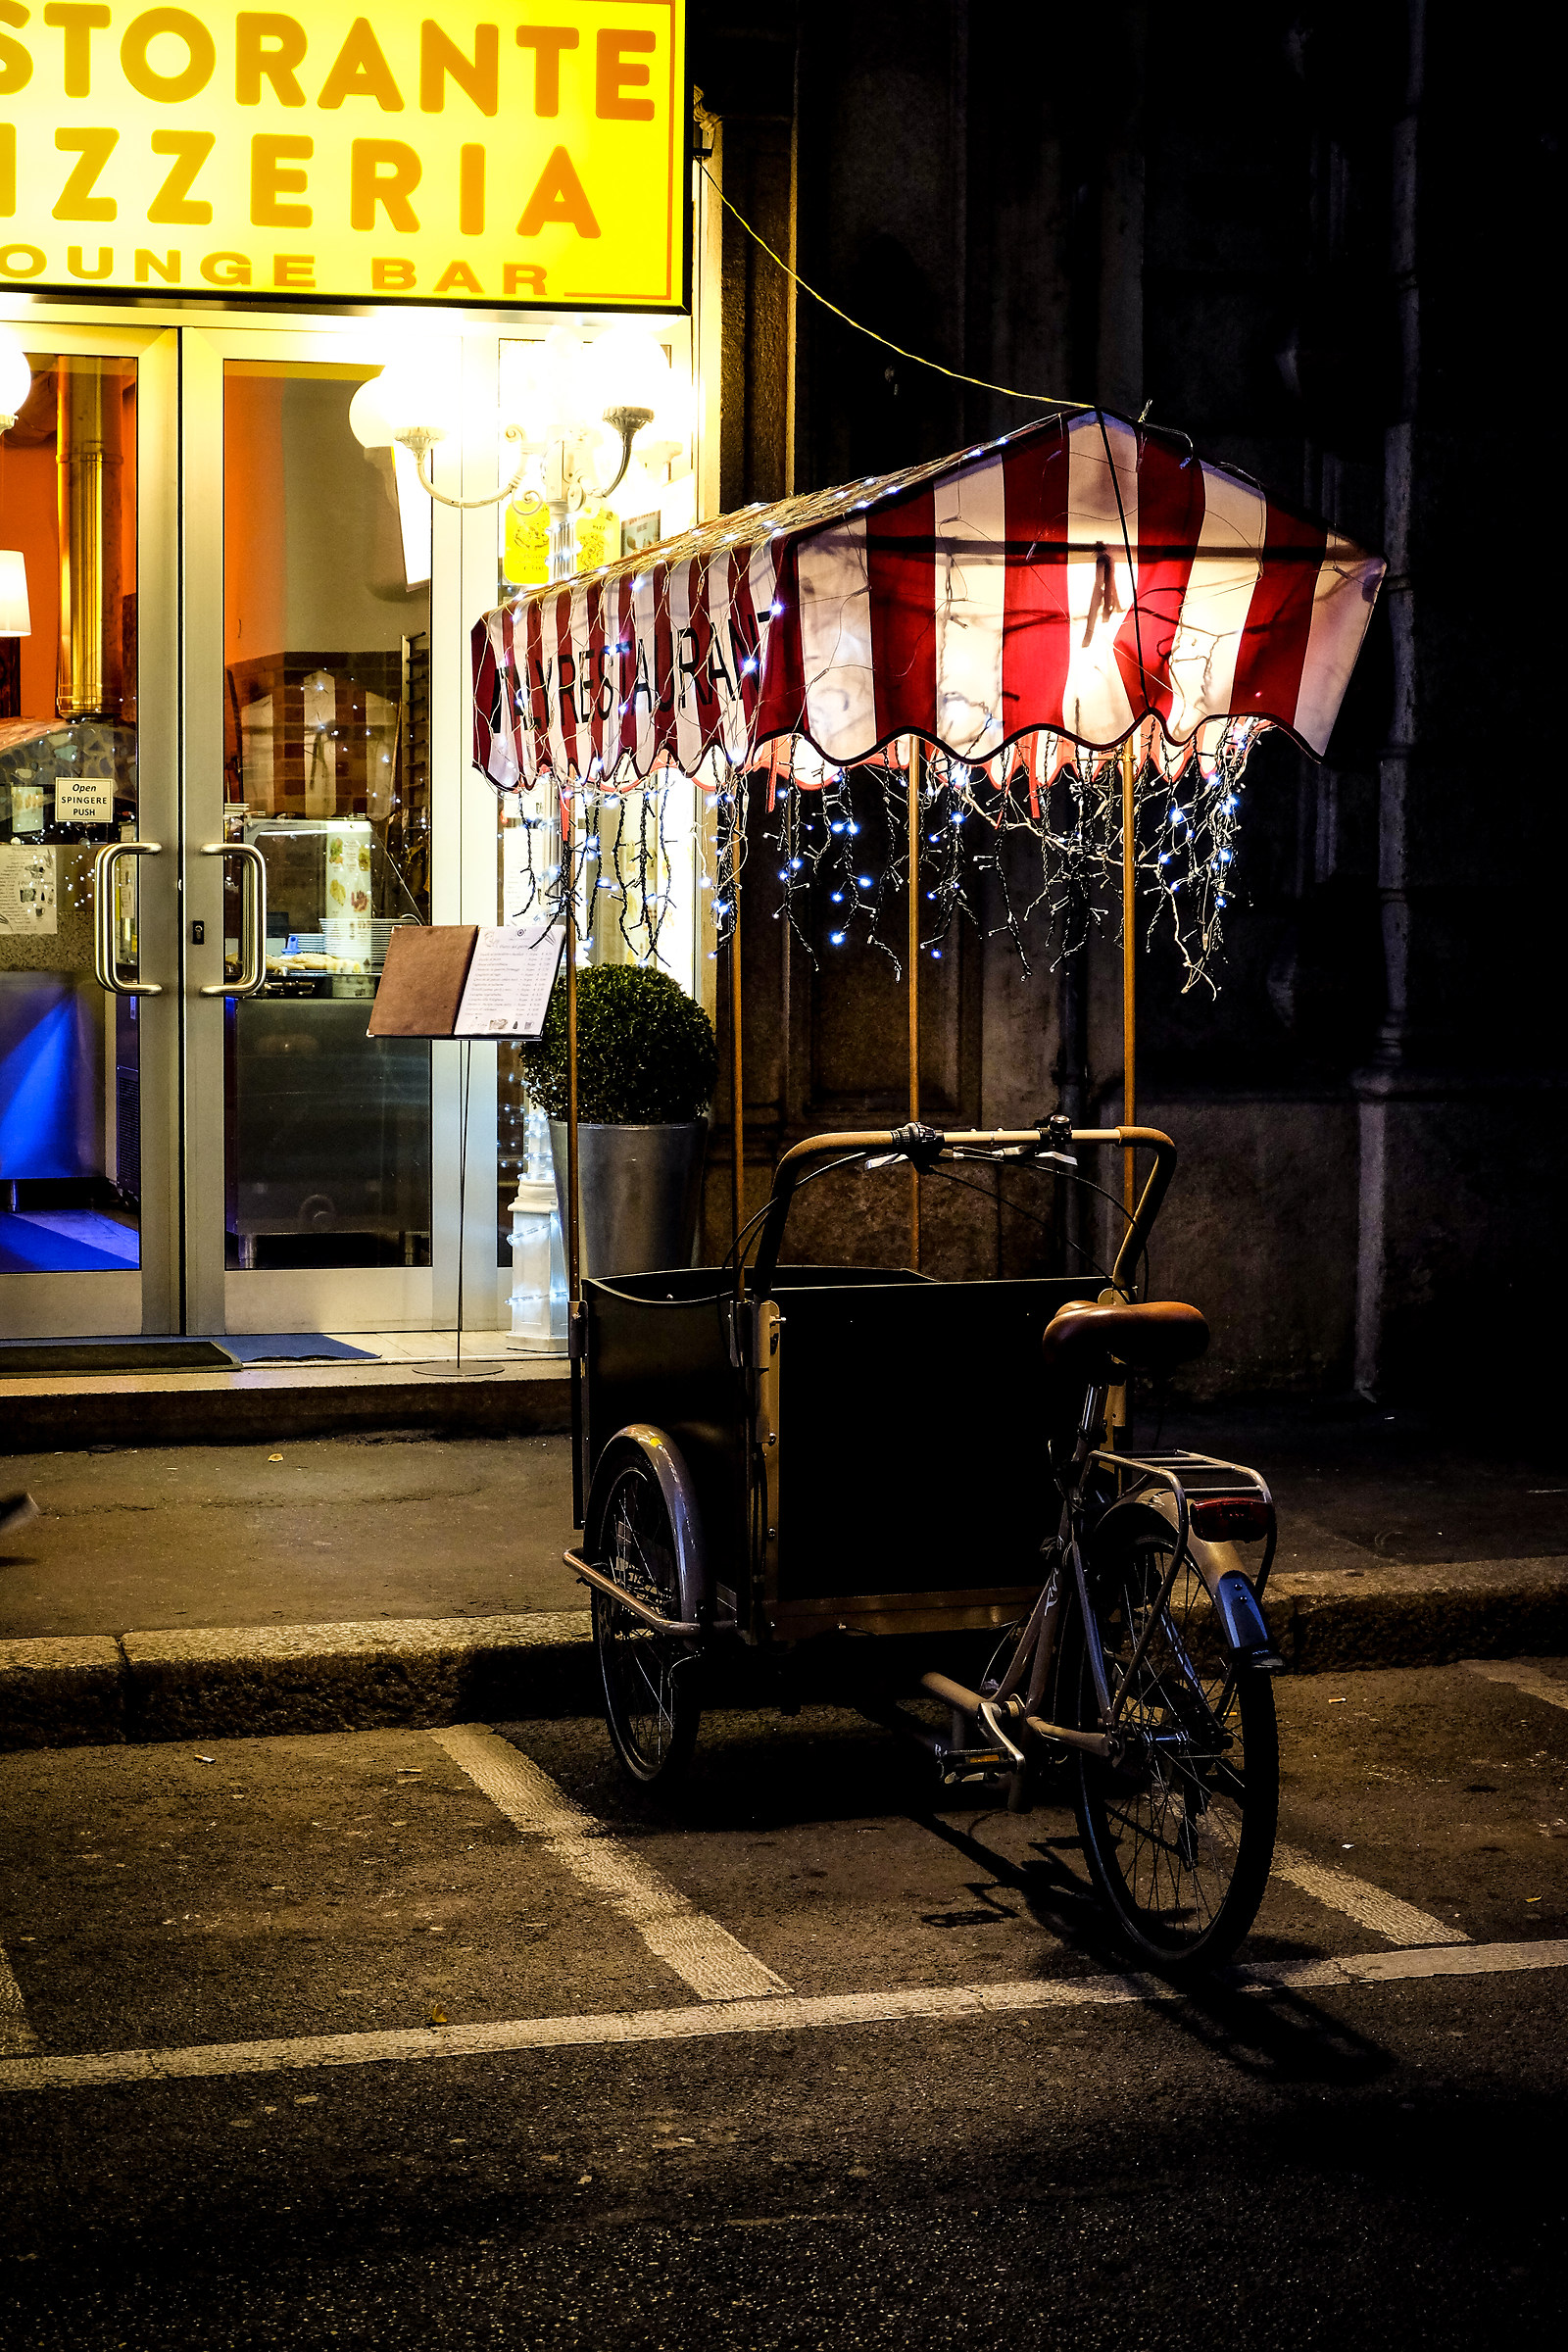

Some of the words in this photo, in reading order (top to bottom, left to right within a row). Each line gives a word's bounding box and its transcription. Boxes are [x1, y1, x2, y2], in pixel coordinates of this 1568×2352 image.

[0, 244, 316, 288] OUNGE
[371, 257, 548, 296] BAR
[72, 783, 97, 794] Open
[61, 796, 107, 805] SPINGERE
[73, 808, 95, 816] PUSH
